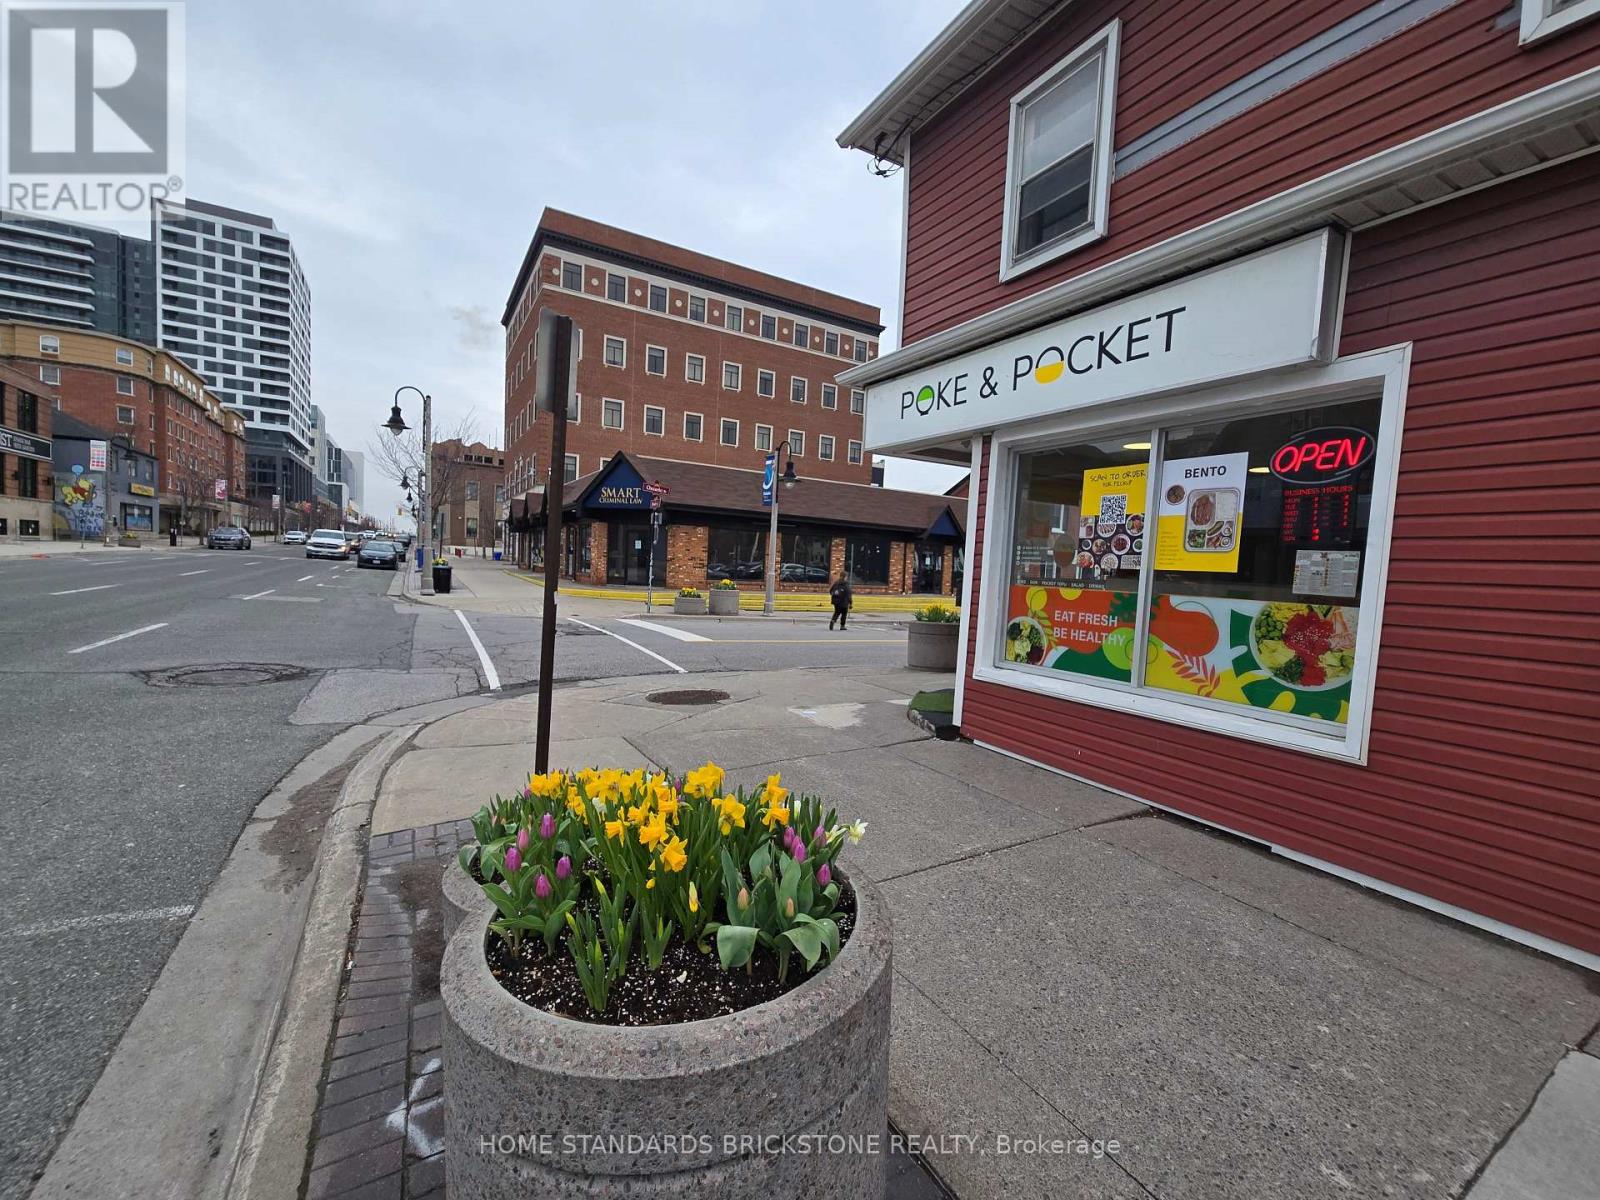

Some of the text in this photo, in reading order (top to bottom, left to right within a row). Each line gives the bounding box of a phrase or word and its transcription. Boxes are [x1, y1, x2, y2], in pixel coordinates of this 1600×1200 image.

[900, 306, 1187, 420] POKE & POCKET
[1274, 436, 1367, 473] OPEN
[1184, 465, 1227, 478] BENTO
[601, 487, 641, 498] SMART
[1054, 610, 1118, 627] EAT FRESH
[1053, 627, 1126, 646] BE HEALTHY
